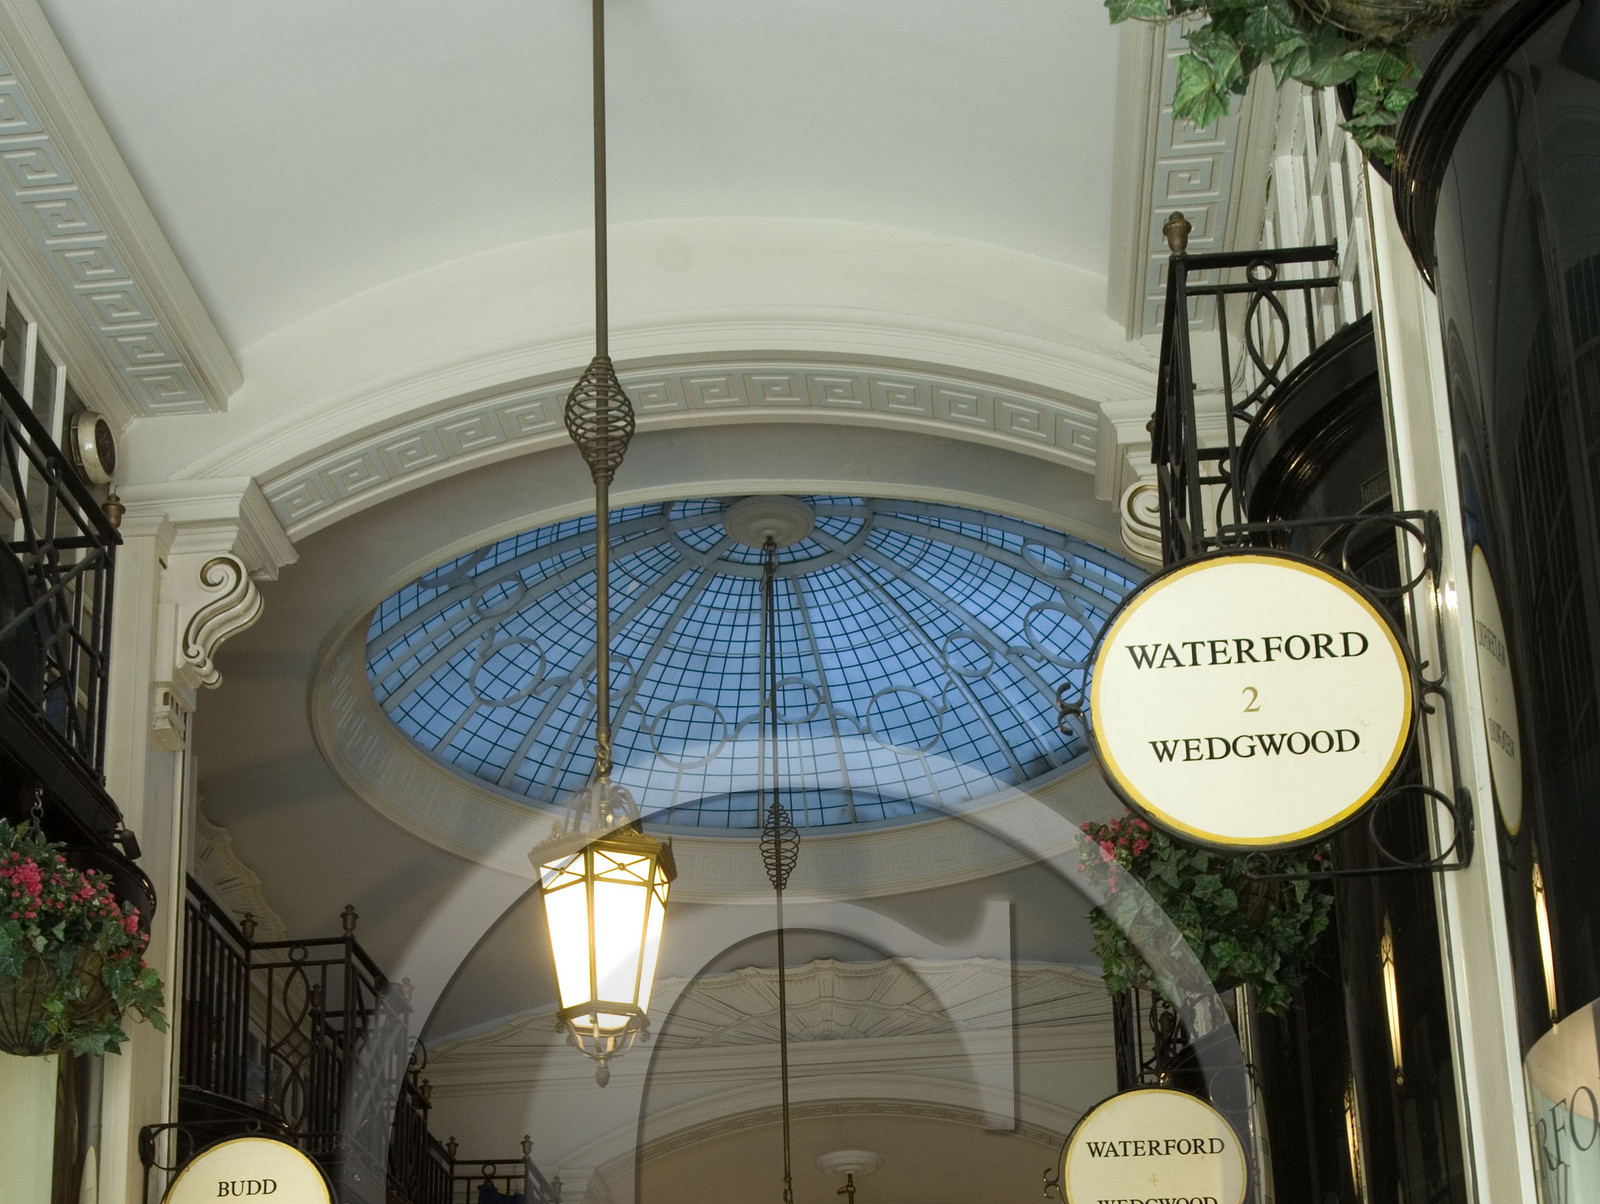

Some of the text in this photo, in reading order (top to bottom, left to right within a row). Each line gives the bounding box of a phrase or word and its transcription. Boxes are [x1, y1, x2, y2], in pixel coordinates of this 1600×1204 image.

[1125, 631, 1369, 670] WATERFORD
[1242, 686, 1261, 712] 2
[1148, 729, 1360, 763] WEDGWOOD
[1086, 1138, 1225, 1158] WATERFORD
[217, 1179, 277, 1197] BUDD
[1147, 1172, 1159, 1187] 4
